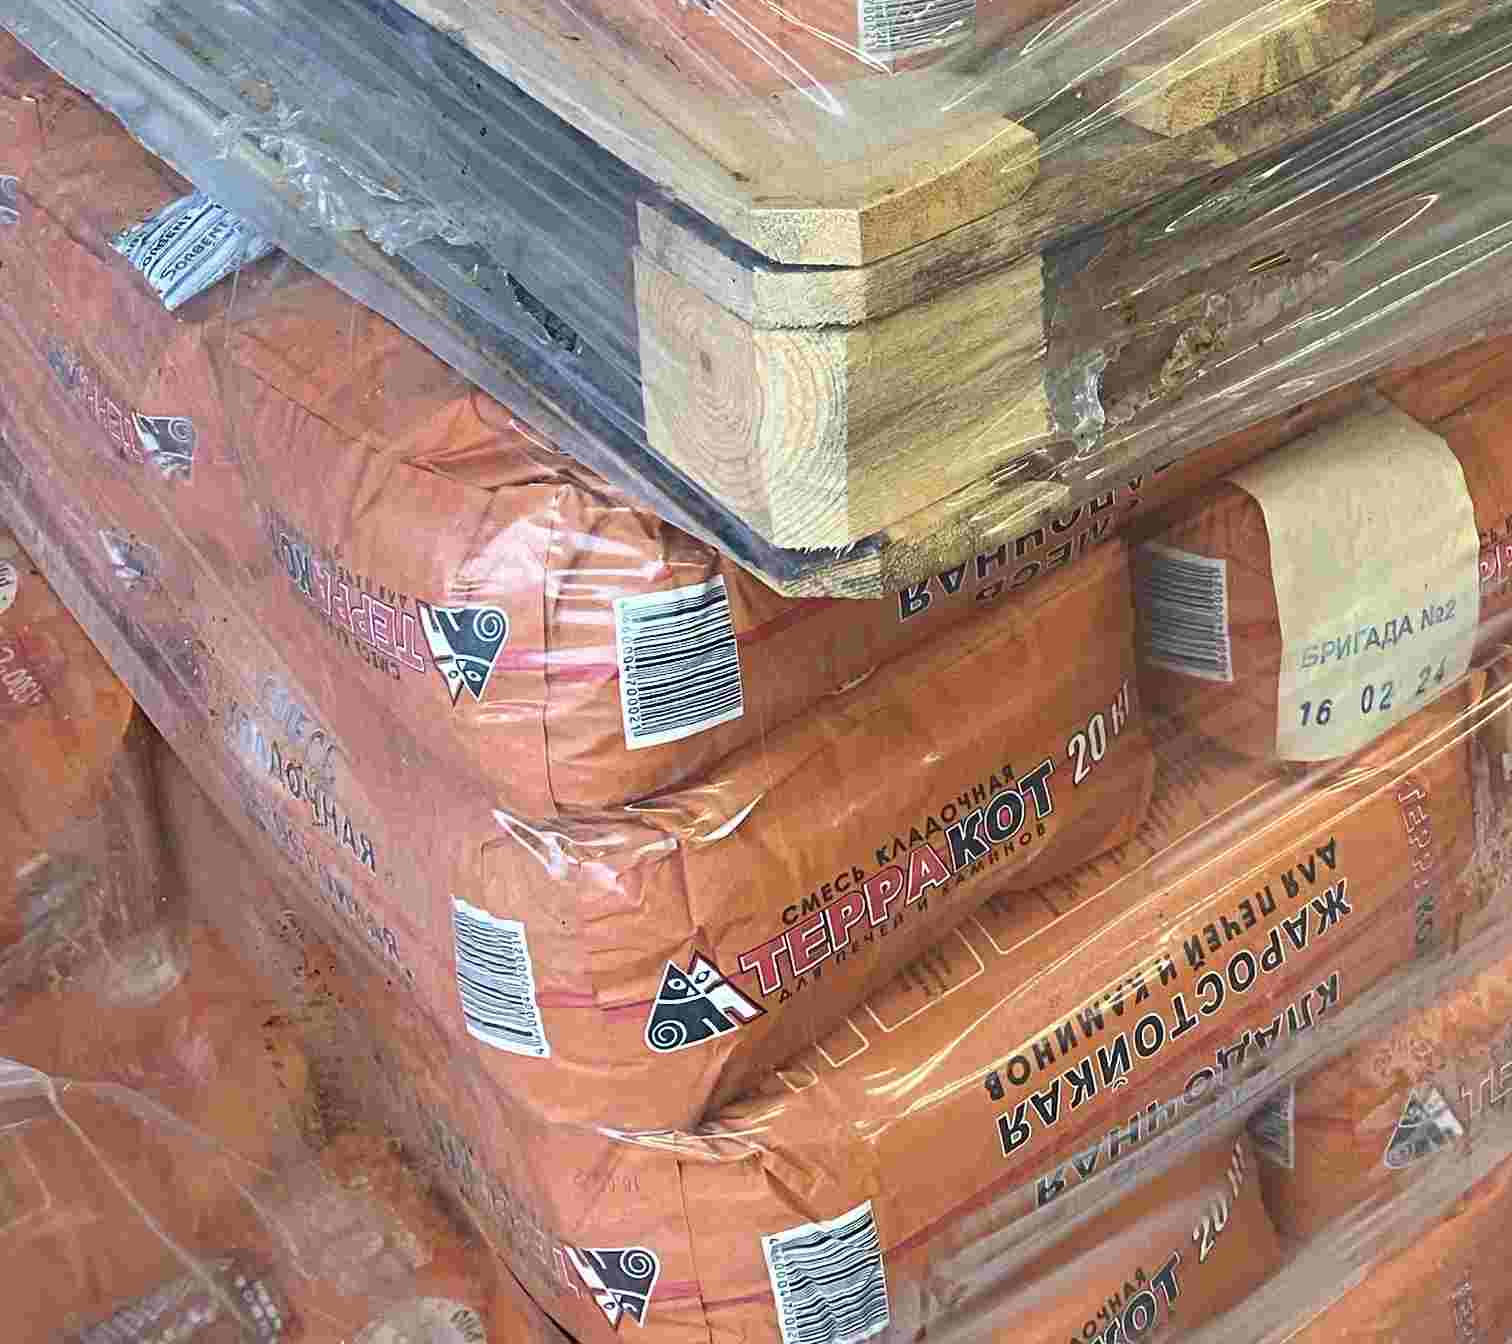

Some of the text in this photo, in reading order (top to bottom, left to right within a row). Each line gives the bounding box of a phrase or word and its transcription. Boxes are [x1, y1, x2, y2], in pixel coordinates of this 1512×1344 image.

[1297, 596, 1458, 671] БРИГАДА №2
[1299, 656, 1449, 731] 16 02 24
[738, 759, 1056, 997] ТЕРРАКОТ
[1067, 727, 1109, 786] 20
[780, 765, 1016, 926] СМЕСЬ КЛАДОЧНАЯ
[1281, 838, 1337, 914] ДЛЯ
[1182, 881, 1280, 974] ПЕЧЕЙ
[983, 974, 1152, 1101] КАМИНОВ
[996, 878, 1351, 1157] ЖАРОСТОЙКАЯ
